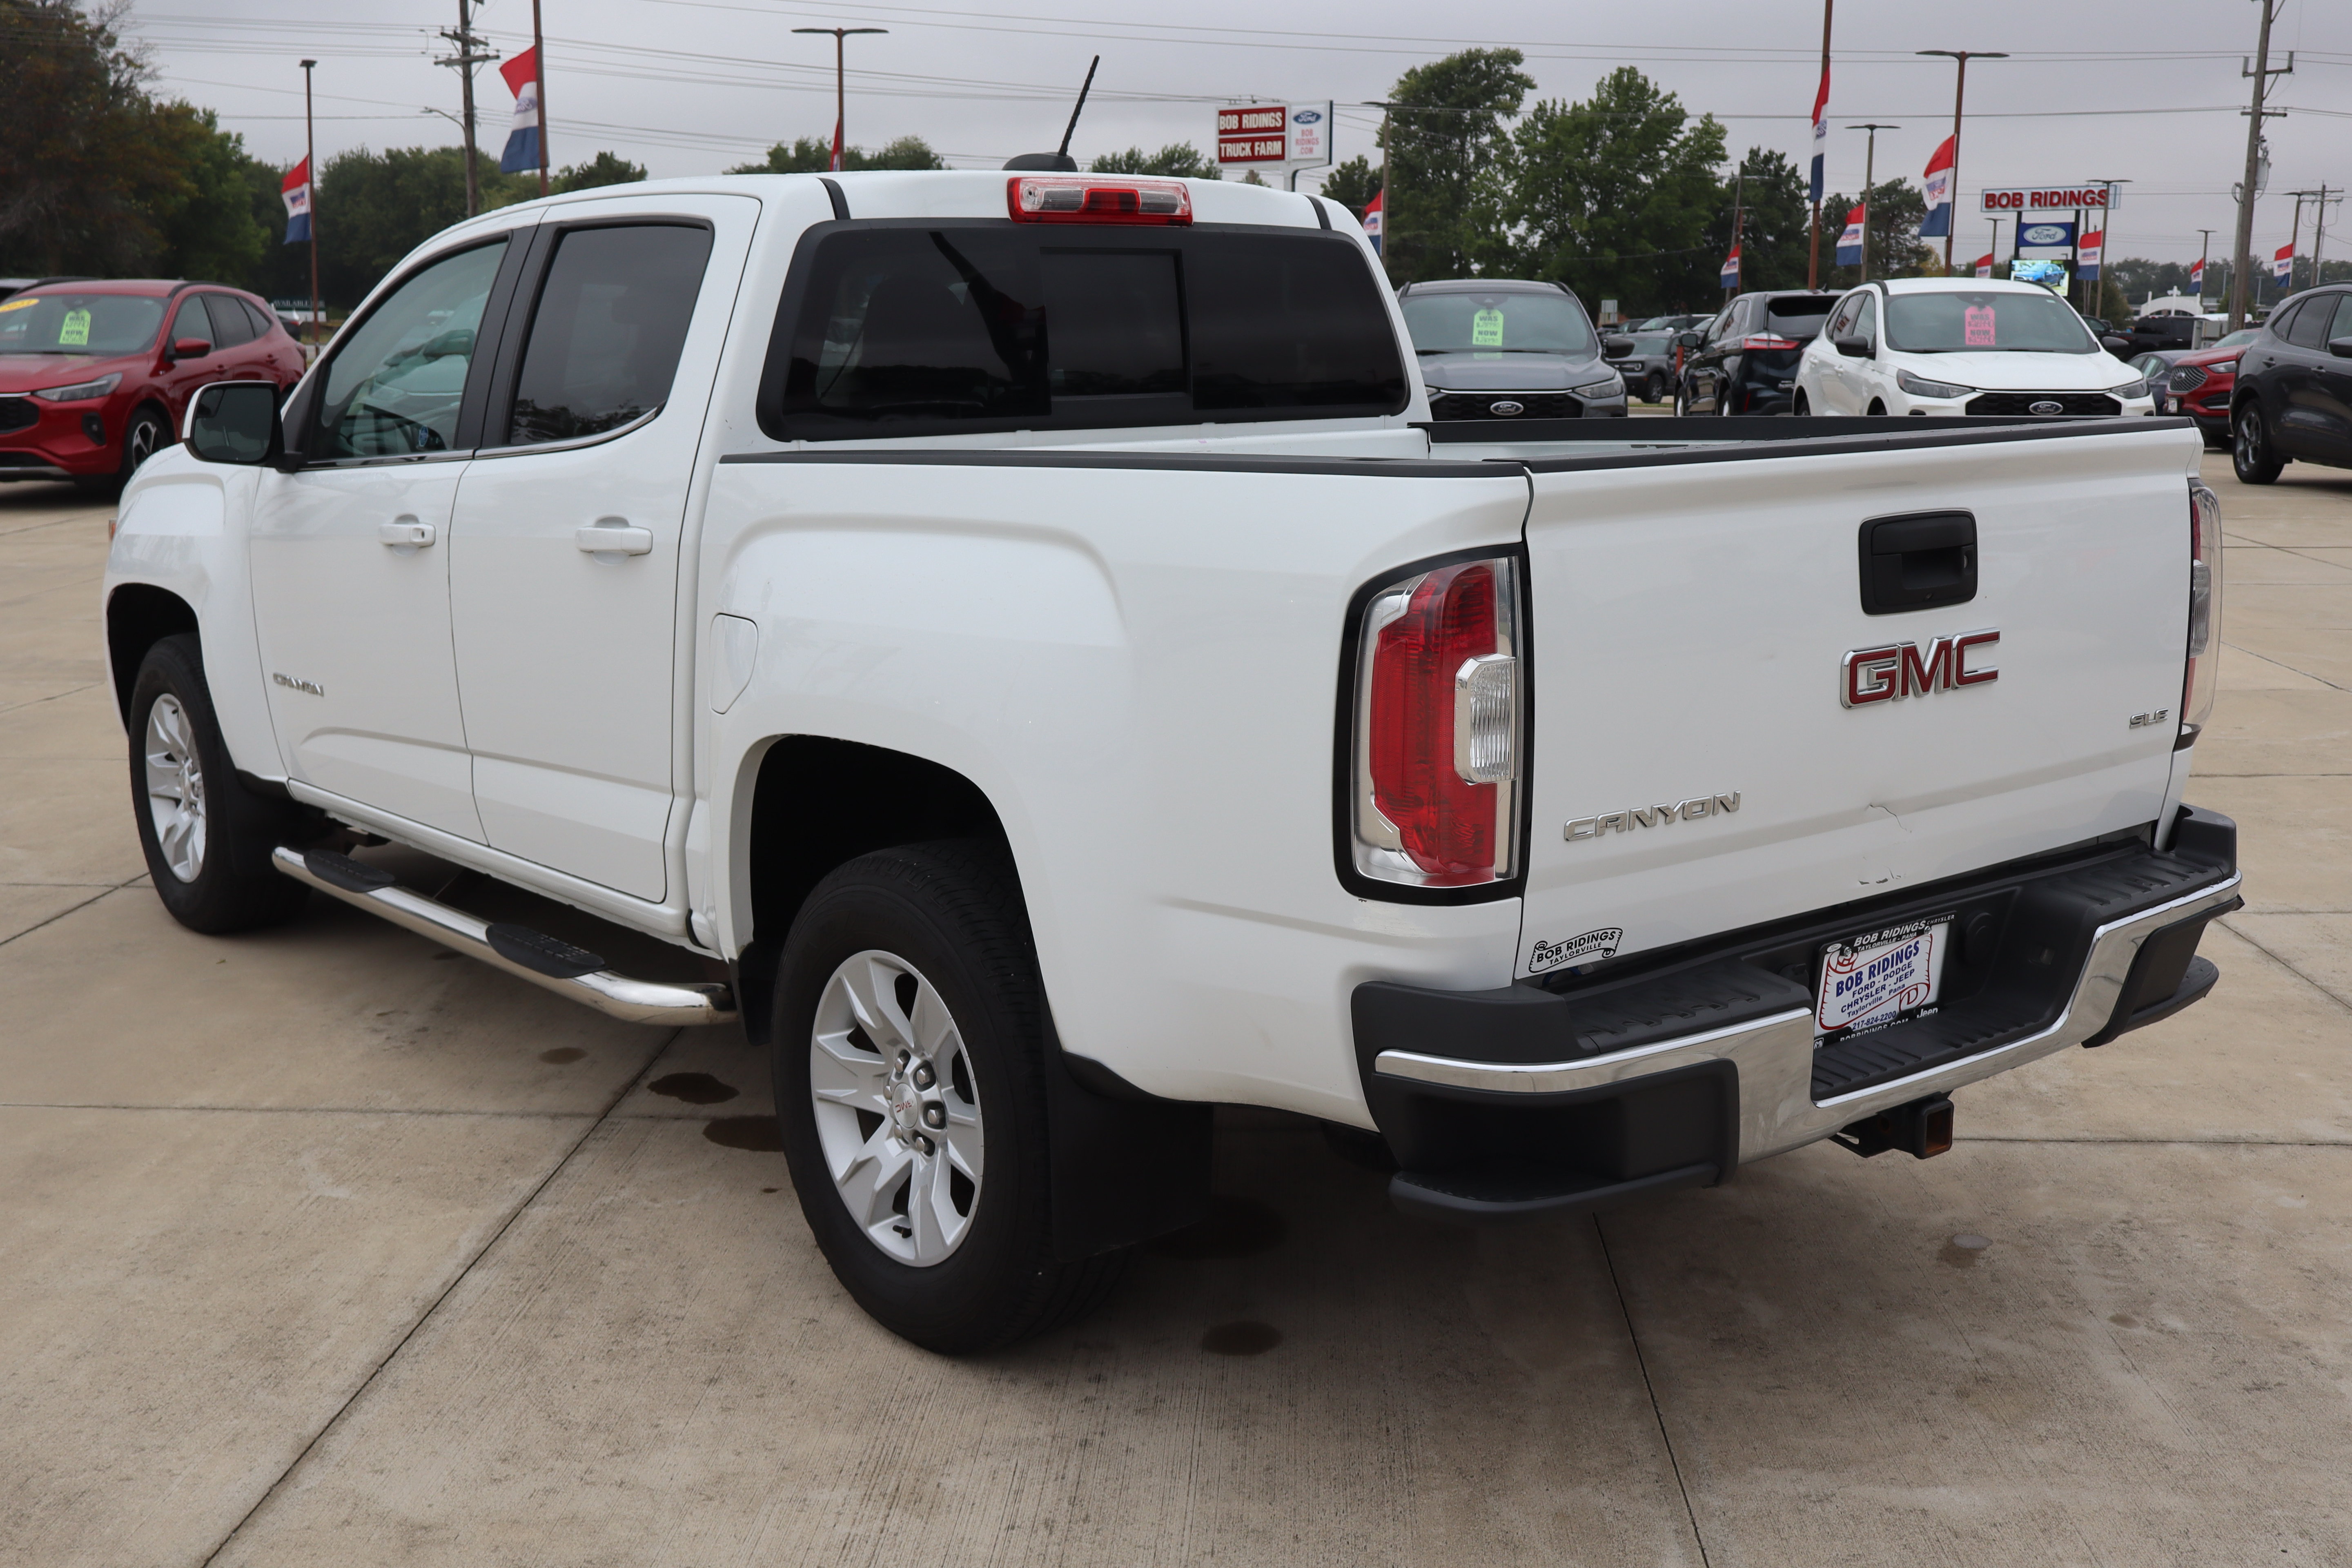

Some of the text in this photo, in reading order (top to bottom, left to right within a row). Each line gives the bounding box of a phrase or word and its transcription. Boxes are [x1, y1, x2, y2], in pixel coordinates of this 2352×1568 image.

[1219, 112, 1282, 130] BOB RIDINGS
[1298, 112, 1316, 122] Ford
[1220, 140, 1282, 157] TRUCK FARM
[1295, 137, 1319, 146] RIDINGS
[1985, 189, 2107, 208] BOB RIDINGS
[2032, 228, 2057, 240] Ford
[1841, 627, 2000, 709] GMC
[2129, 708, 2168, 729] SLE
[1564, 790, 1740, 841] CANYON
[1927, 915, 1955, 925] CHRYSLER
[1853, 920, 1926, 947] BOB RIDINGS
[1858, 938, 1896, 952] TAYLORVILLE
[1901, 932, 1917, 940] PANA
[1537, 931, 1616, 963] BOB RIDINGS
[1549, 942, 1601, 965] TAYLORVILLE
[1836, 940, 1919, 997] BOB RIDINGS
[1852, 981, 1875, 998] FORD
[1883, 960, 1913, 982] DODGE
[1841, 984, 1886, 1013] CHRYSLER
[1894, 969, 1915, 985] JEEP
[1847, 983, 1905, 1018] Taylorville Pana
[1852, 1010, 1896, 1030] 217-824-2200
